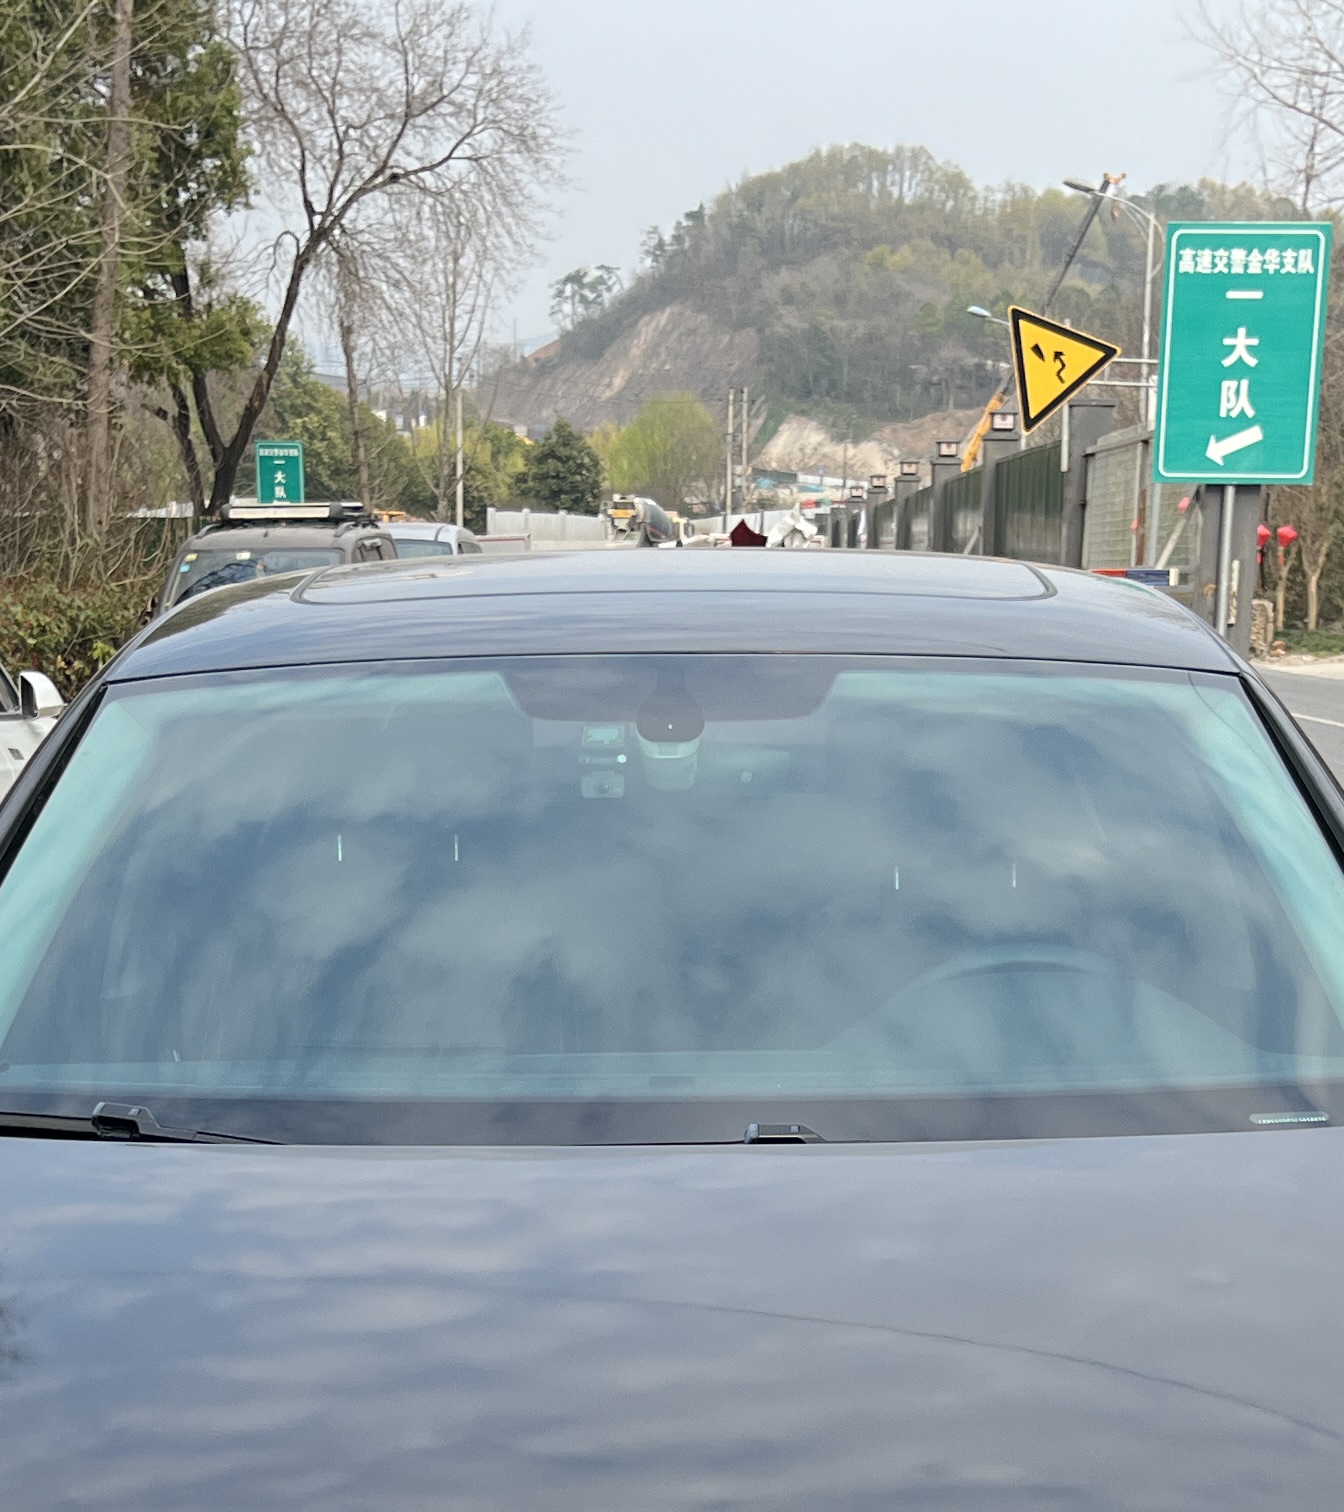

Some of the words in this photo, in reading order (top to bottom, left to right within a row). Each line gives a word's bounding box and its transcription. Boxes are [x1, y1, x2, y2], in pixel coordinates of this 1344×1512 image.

[1178, 248, 1315, 275] 高速交警金华支队
[1218, 289, 1265, 419] 一大队
